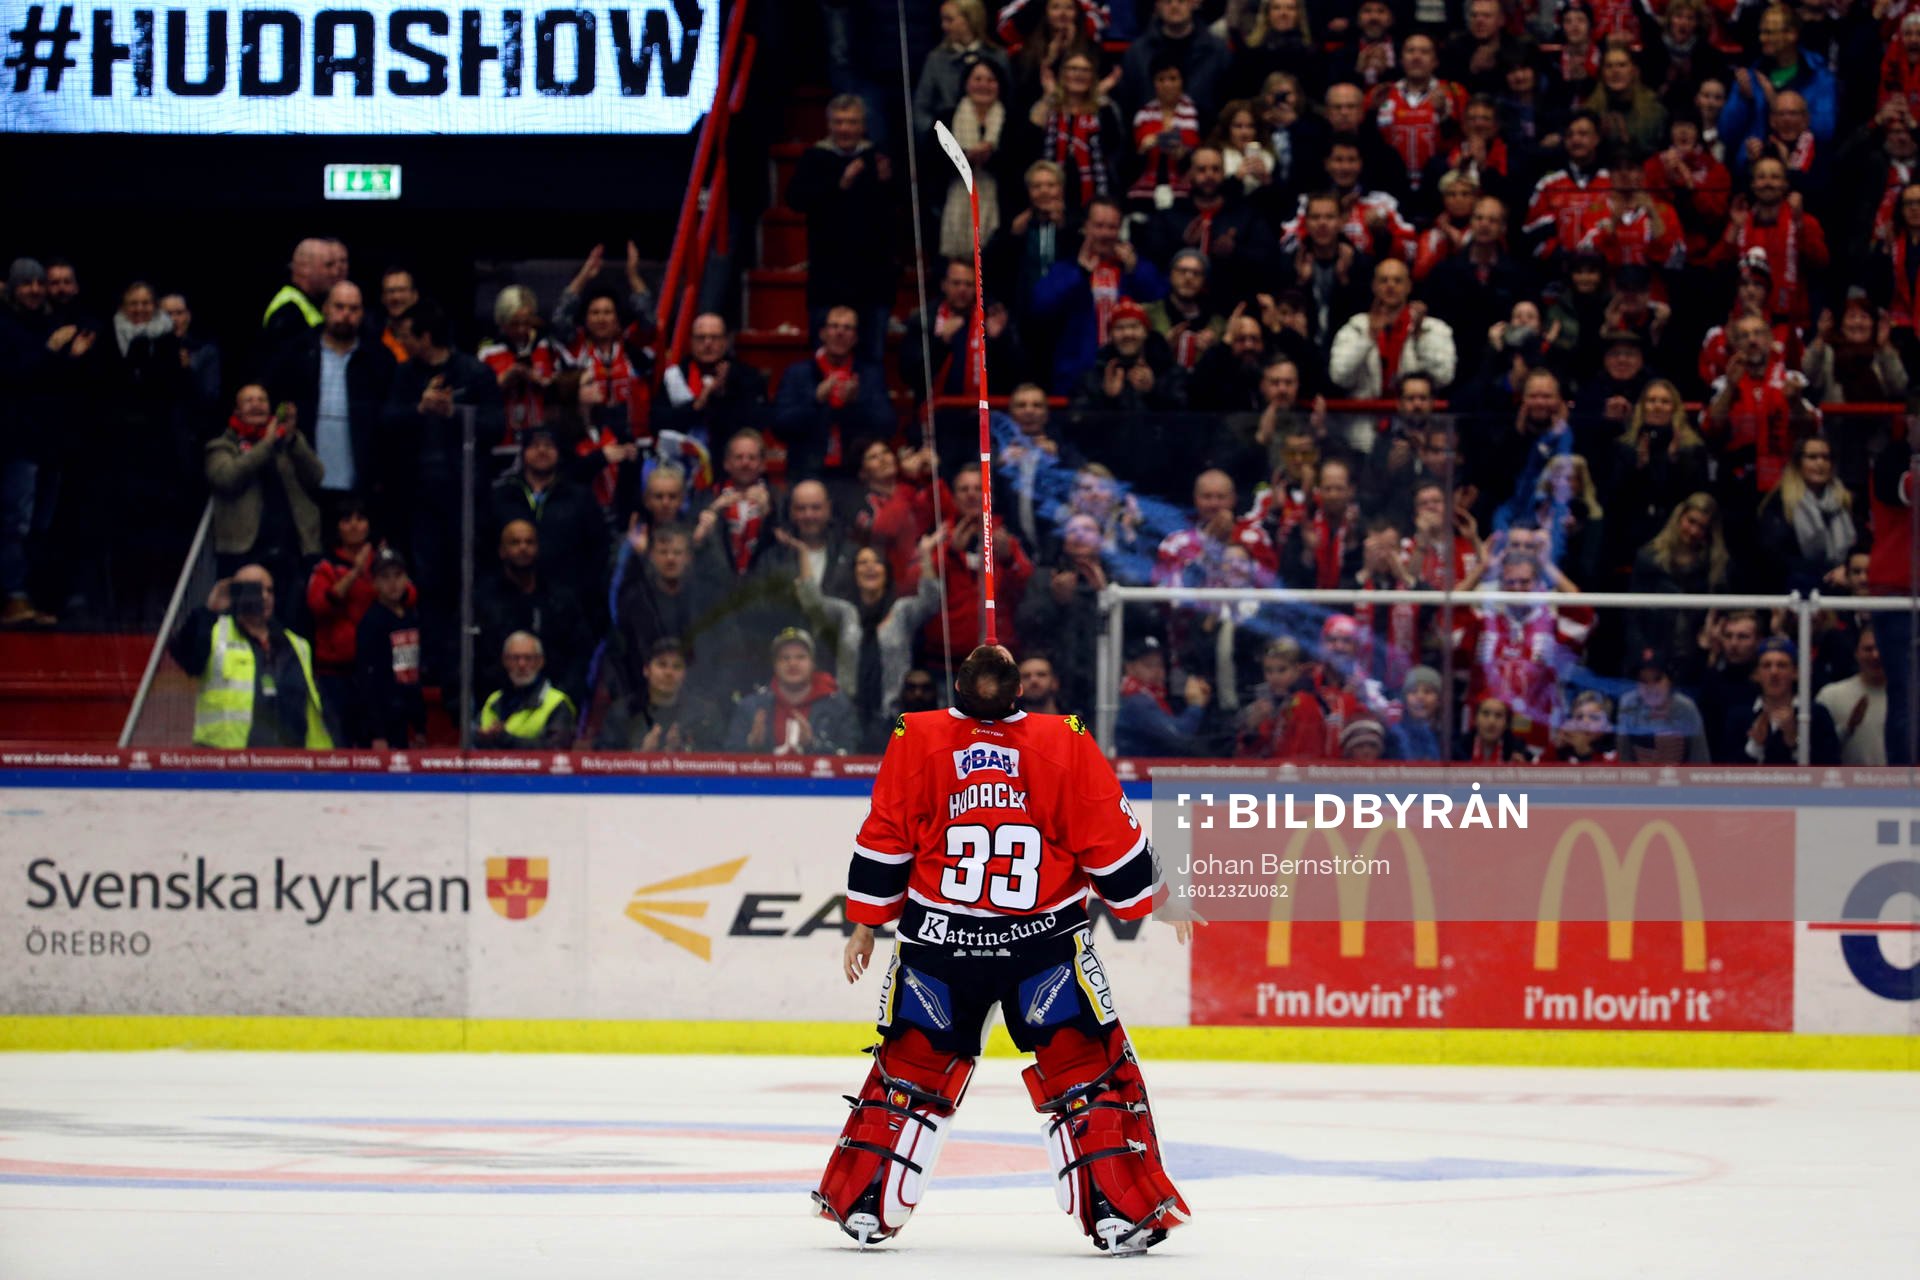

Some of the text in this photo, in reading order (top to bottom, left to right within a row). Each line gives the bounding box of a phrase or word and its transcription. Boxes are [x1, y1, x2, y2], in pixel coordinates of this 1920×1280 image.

[4, 5, 706, 98] #HUDASHOW
[949, 782, 1026, 820] HUDACEK
[940, 824, 1041, 910] 33
[26, 857, 470, 925] Svenska kyrkan
[26, 926, 151, 957] ÖREBRO
[1257, 983, 1310, 1017] i'm
[1316, 984, 1411, 1018] lovin'
[1525, 986, 1577, 1020] i'm
[1584, 987, 1680, 1022] lovin'
